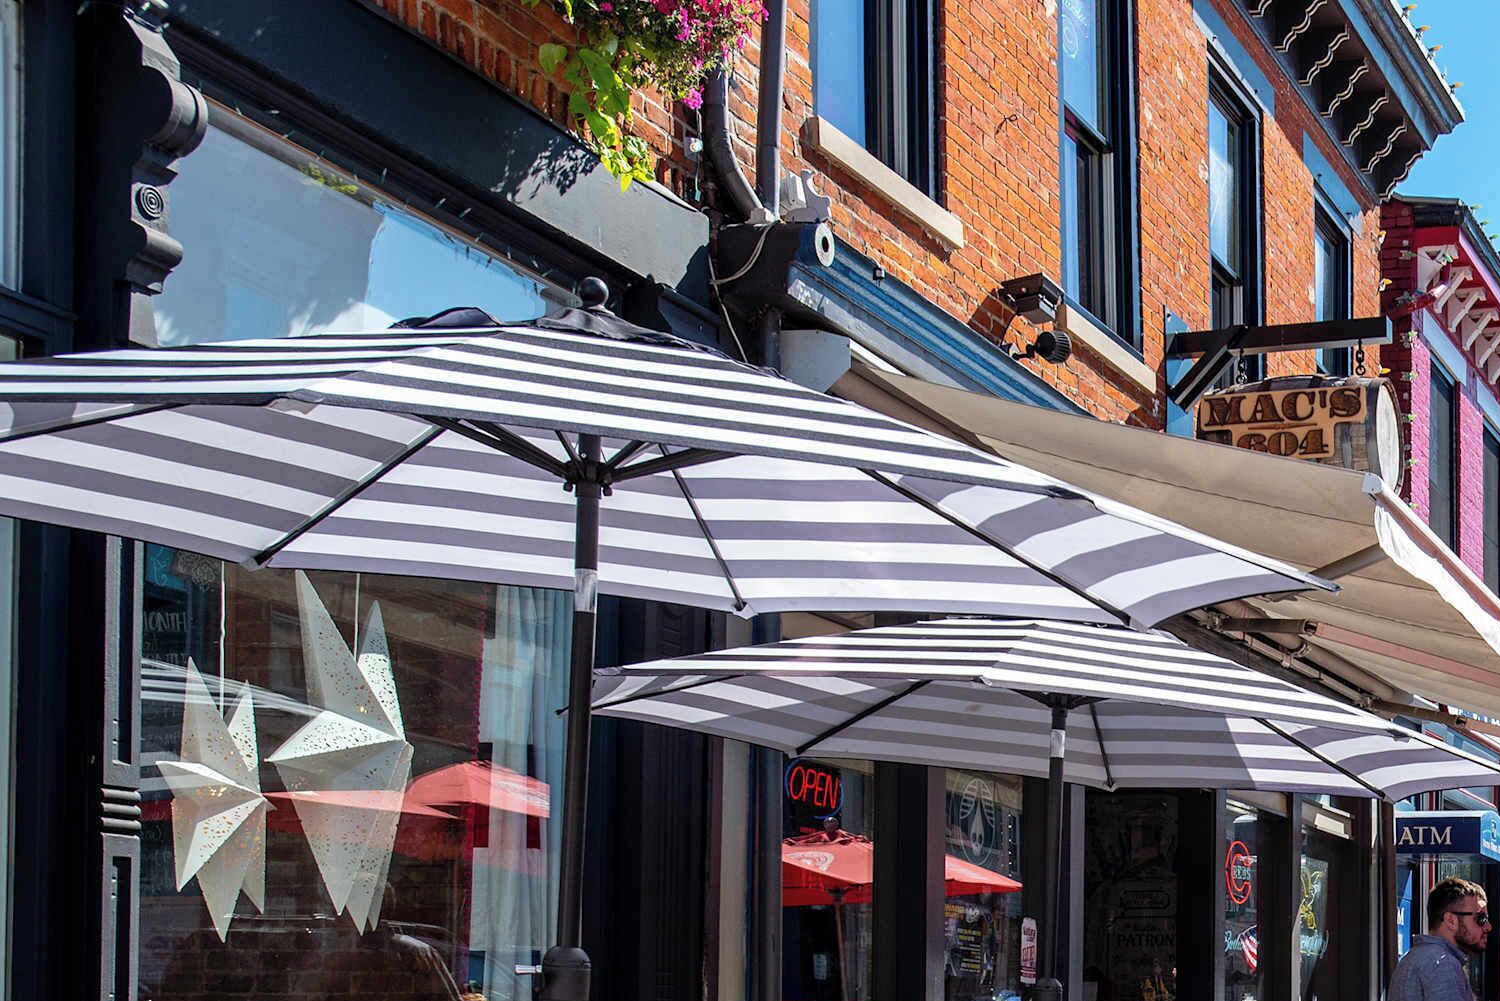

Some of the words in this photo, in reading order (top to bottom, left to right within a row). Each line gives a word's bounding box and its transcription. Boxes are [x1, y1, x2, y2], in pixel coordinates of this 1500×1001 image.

[1204, 387, 1362, 427] MAC'S
[789, 766, 839, 810] OPEN
[1398, 826, 1453, 846] ATM
